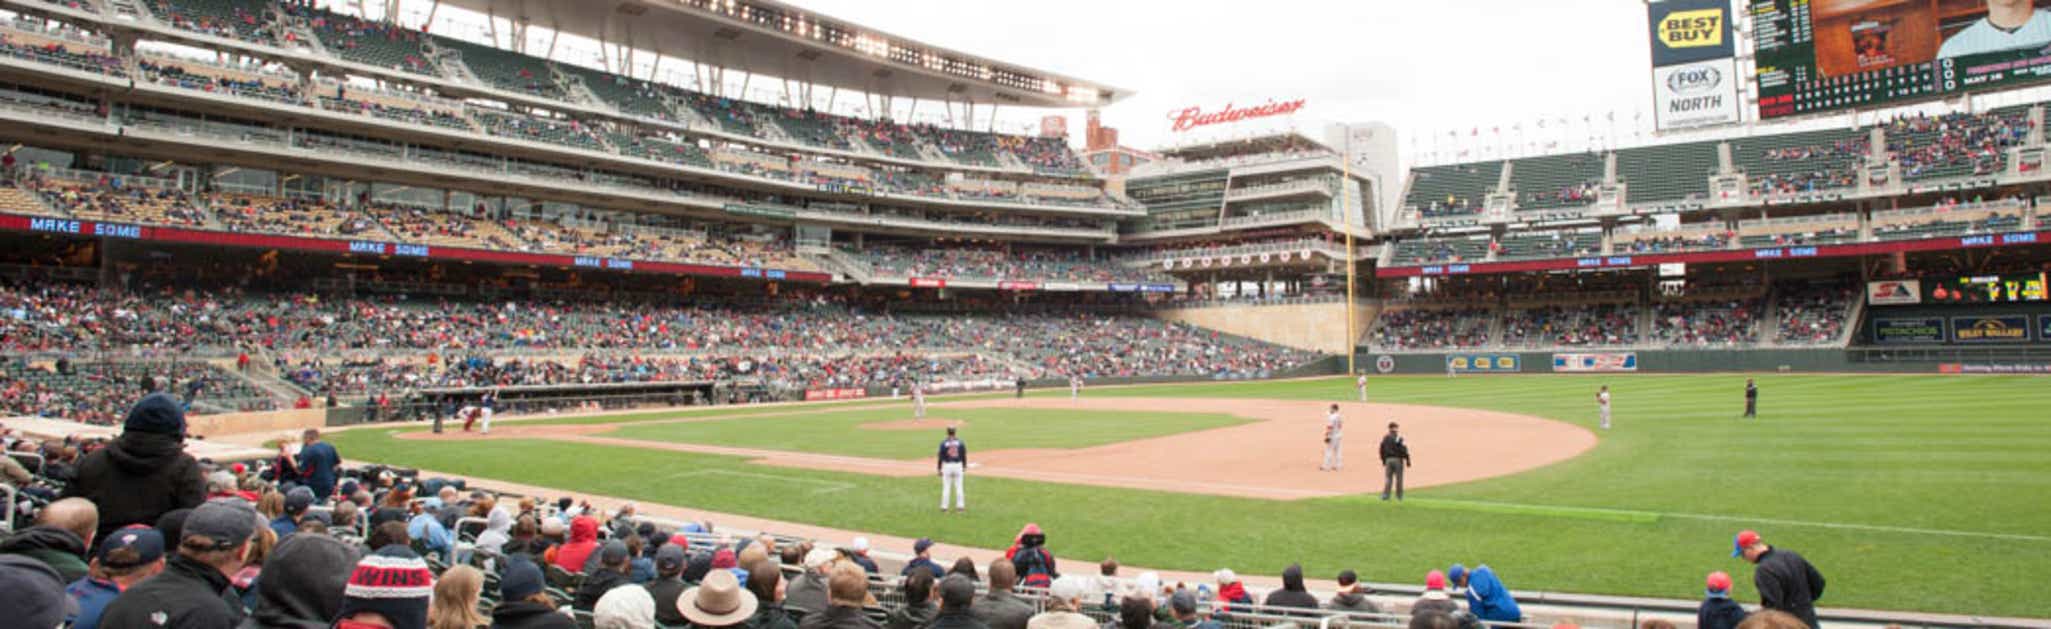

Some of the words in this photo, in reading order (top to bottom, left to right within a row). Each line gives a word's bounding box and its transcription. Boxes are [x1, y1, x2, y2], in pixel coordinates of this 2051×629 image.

[1667, 16, 1719, 30] BEST
[1669, 29, 1713, 42] BUY
[1678, 69, 1709, 85] FOX
[1669, 94, 1722, 112] NORTH
[1167, 98, 1305, 131] Budweiser
[31, 218, 80, 233] MAKE
[95, 223, 140, 238] SOME
[349, 241, 385, 254] MAKE
[396, 244, 429, 256] SOME
[357, 566, 424, 586] WINS
